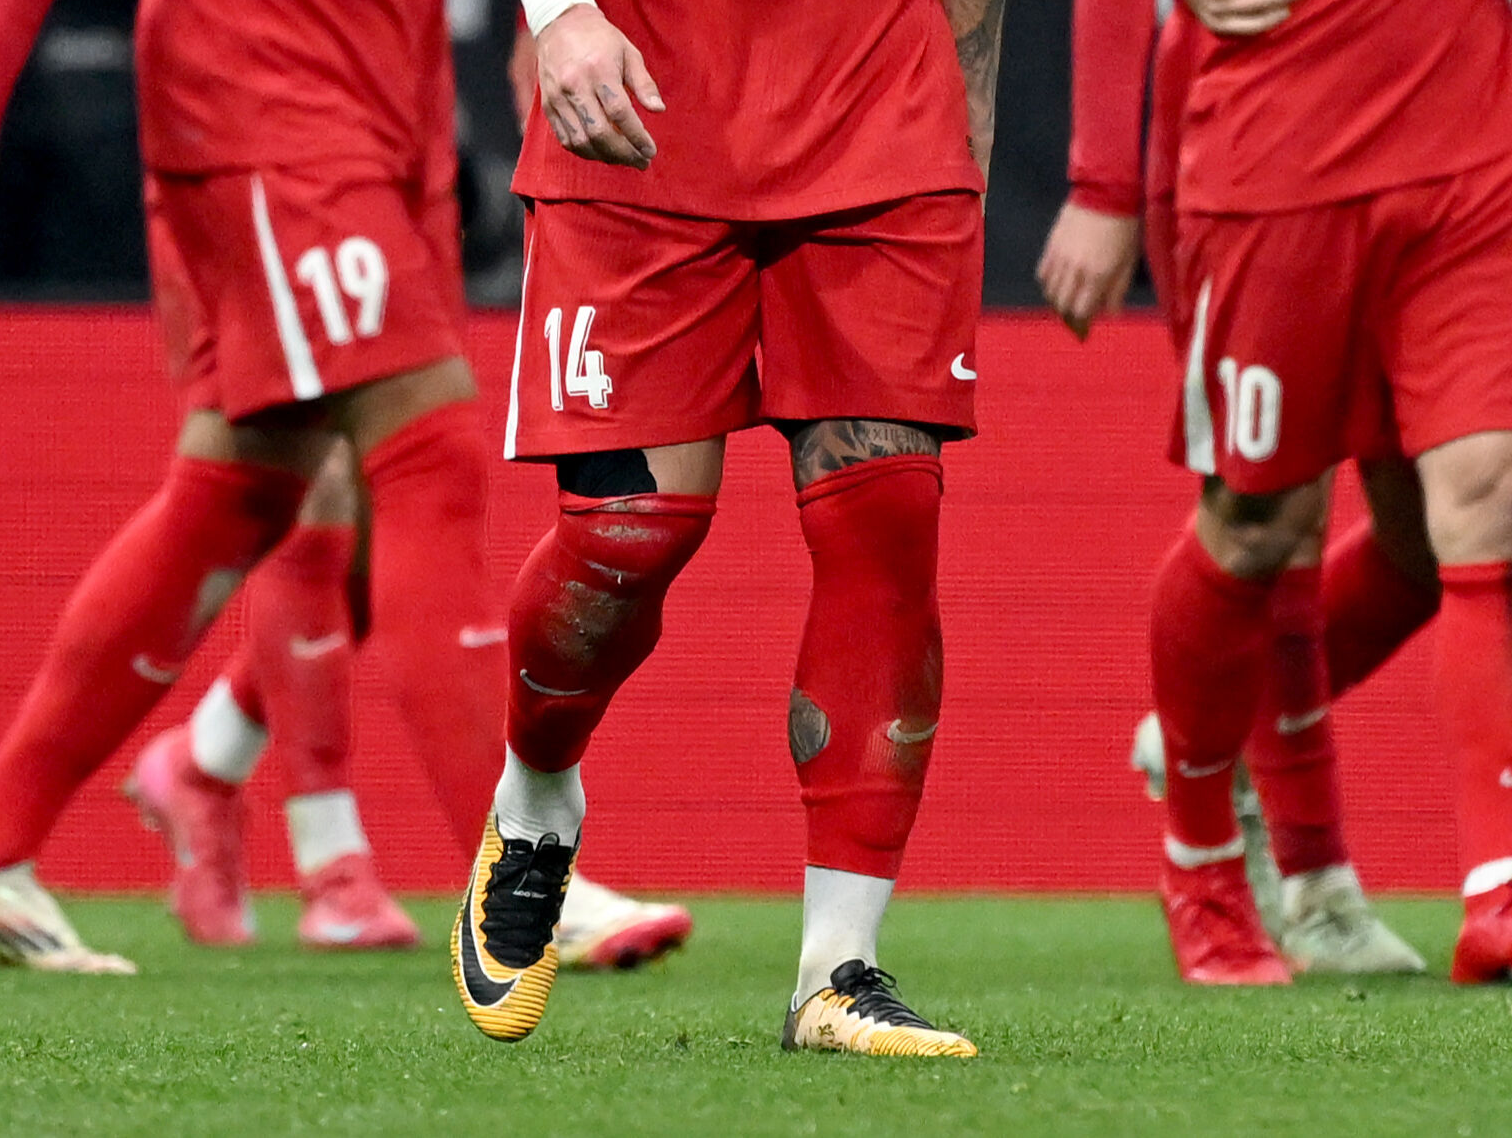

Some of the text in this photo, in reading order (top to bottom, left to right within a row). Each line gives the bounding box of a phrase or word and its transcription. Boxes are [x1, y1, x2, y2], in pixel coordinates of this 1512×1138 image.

[296, 236, 389, 346] 19
[544, 306, 613, 411] 14
[1217, 356, 1283, 463] 10
